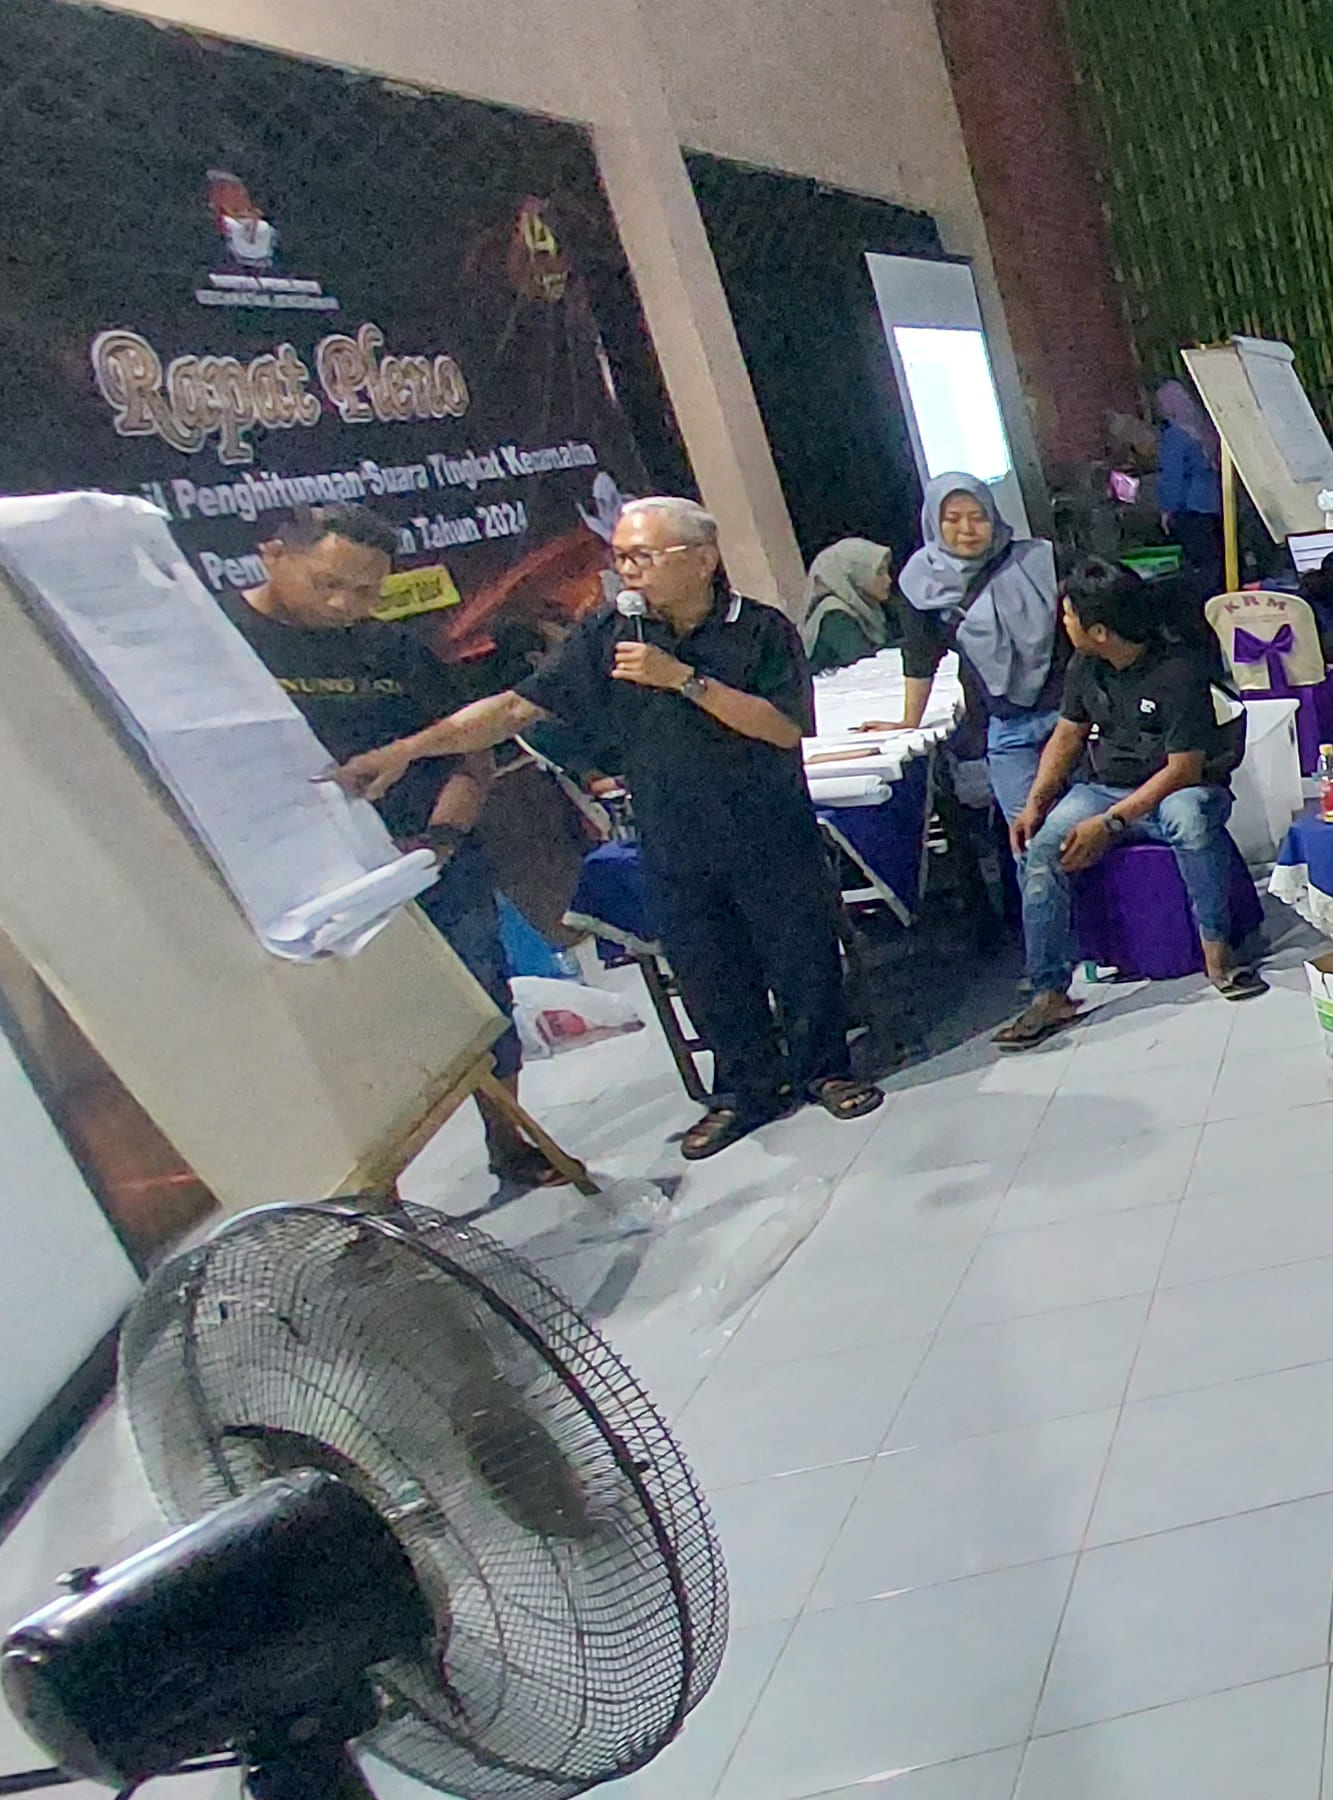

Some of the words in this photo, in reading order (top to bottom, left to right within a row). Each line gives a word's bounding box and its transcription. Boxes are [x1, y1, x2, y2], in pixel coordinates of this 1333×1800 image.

[92, 330, 320, 465] Rapat
[316, 322, 470, 423] Pleno
[171, 469, 366, 522] Penghitungan
[360, 460, 430, 496] Suara
[427, 449, 507, 490] Tingkat
[409, 514, 482, 550] Tahun
[475, 501, 529, 539] 2024
